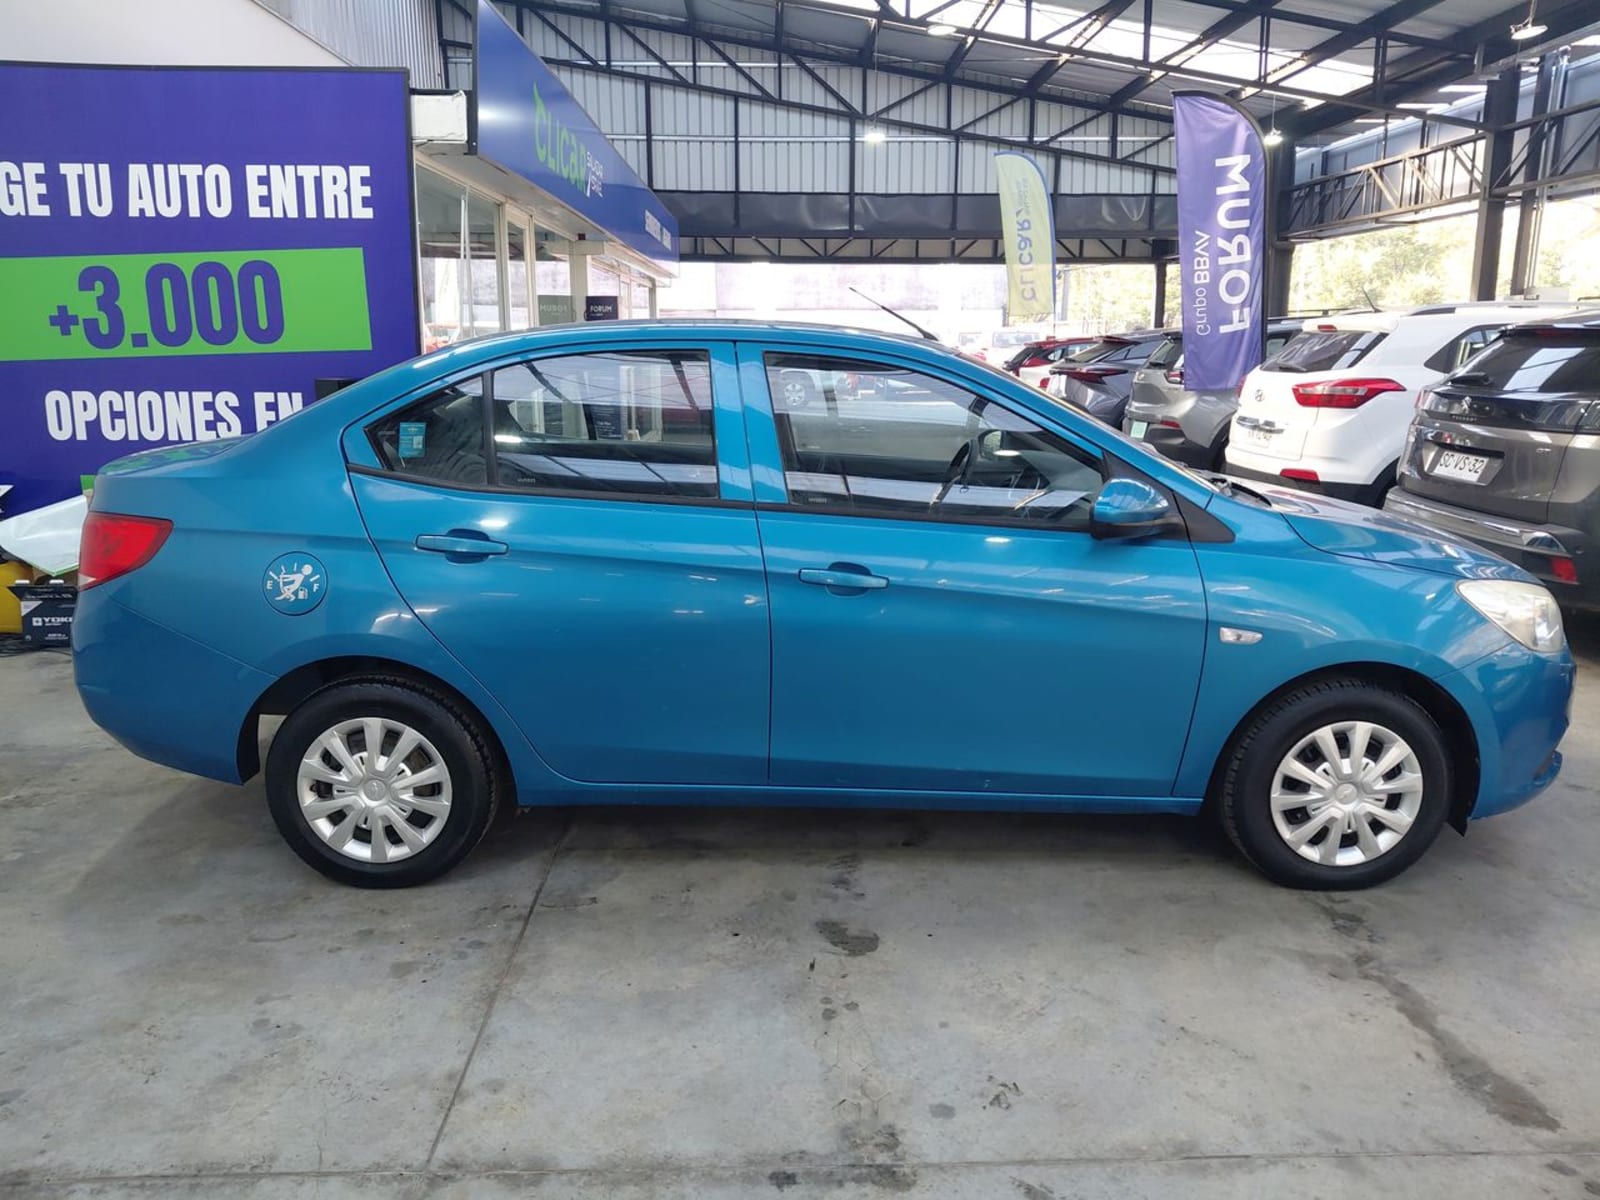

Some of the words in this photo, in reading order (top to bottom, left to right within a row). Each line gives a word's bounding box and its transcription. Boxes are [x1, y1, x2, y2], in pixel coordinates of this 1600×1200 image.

[0, 161, 51, 217] GE
[59, 162, 113, 218] TU
[127, 163, 233, 219] AUTO
[245, 165, 374, 219] ENTRE
[49, 259, 286, 350] +3.000
[589, 304, 612, 313] FORUM
[44, 389, 243, 442] OPCIONES
